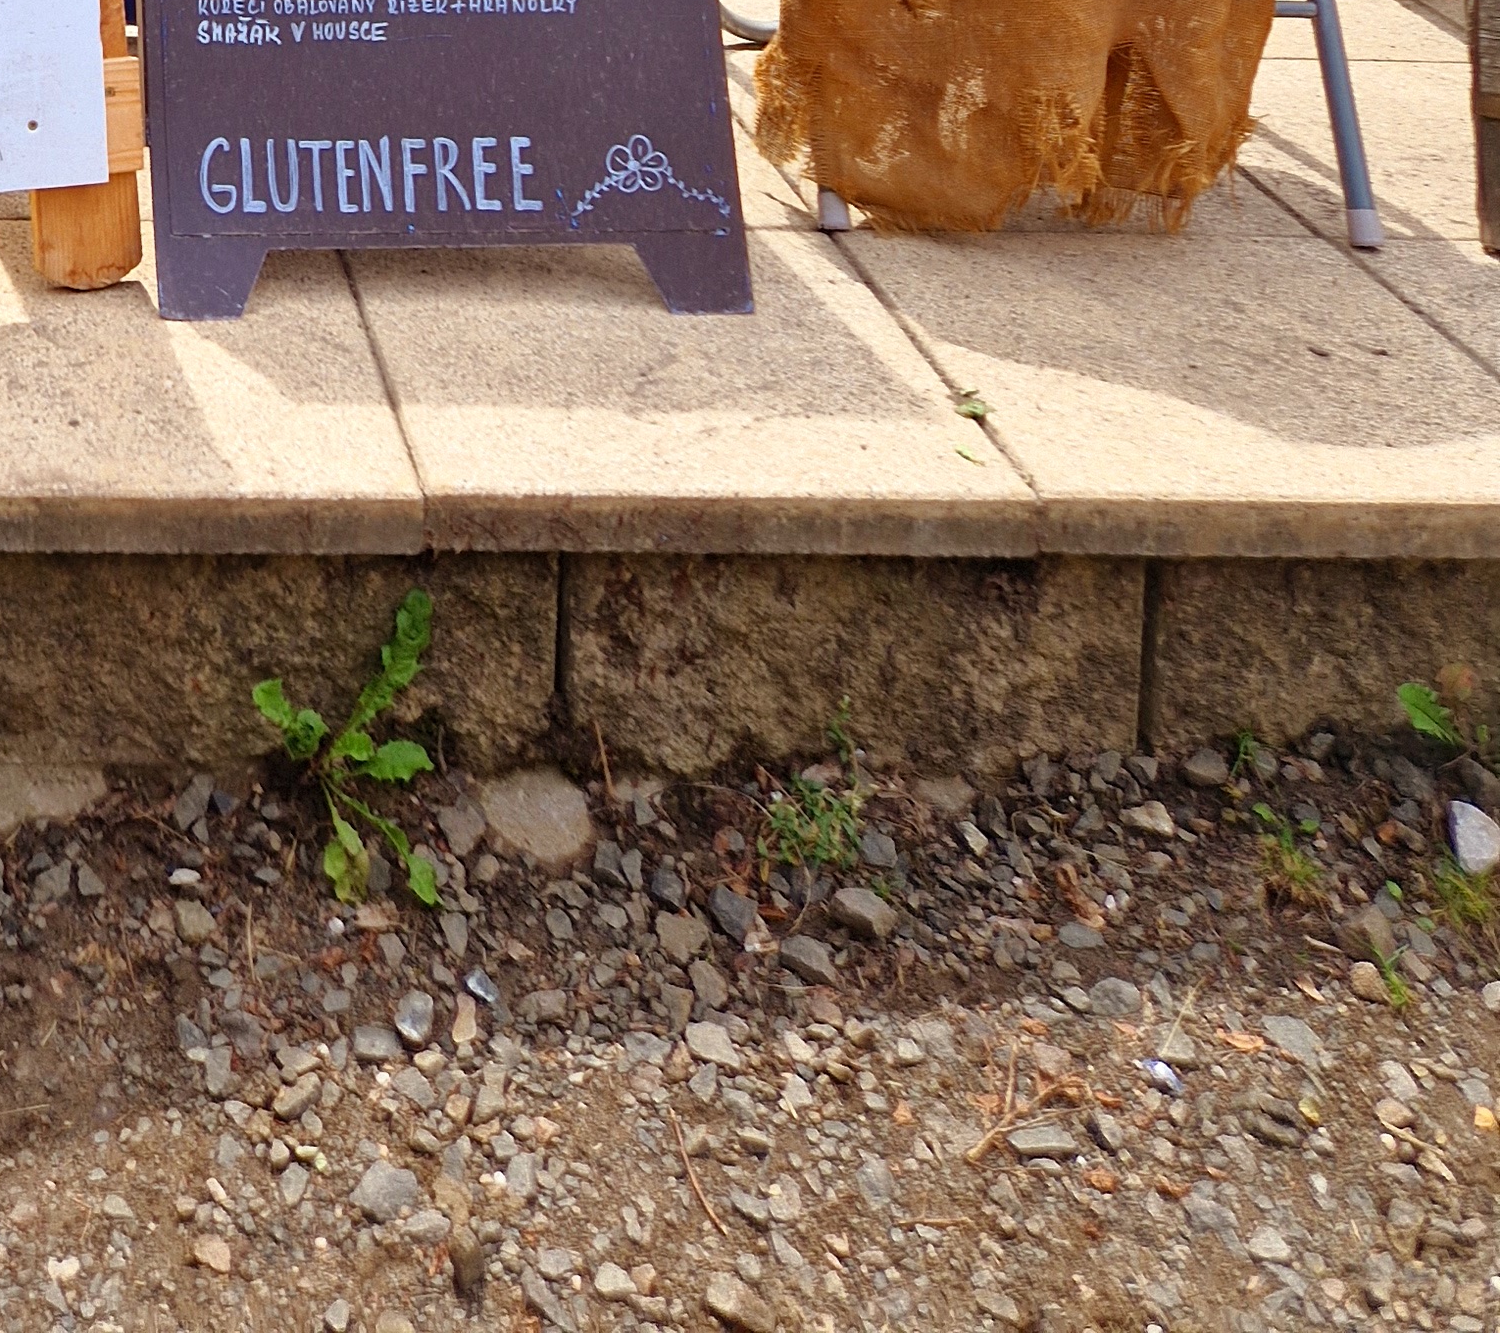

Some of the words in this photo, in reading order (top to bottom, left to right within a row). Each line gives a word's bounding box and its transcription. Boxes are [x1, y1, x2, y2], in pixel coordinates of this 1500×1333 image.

[195, 16, 282, 45] SMAŽÁK
[290, 22, 306, 42] V
[312, 21, 389, 42] HOUSCE
[200, 134, 544, 215] GLUTENFREE
